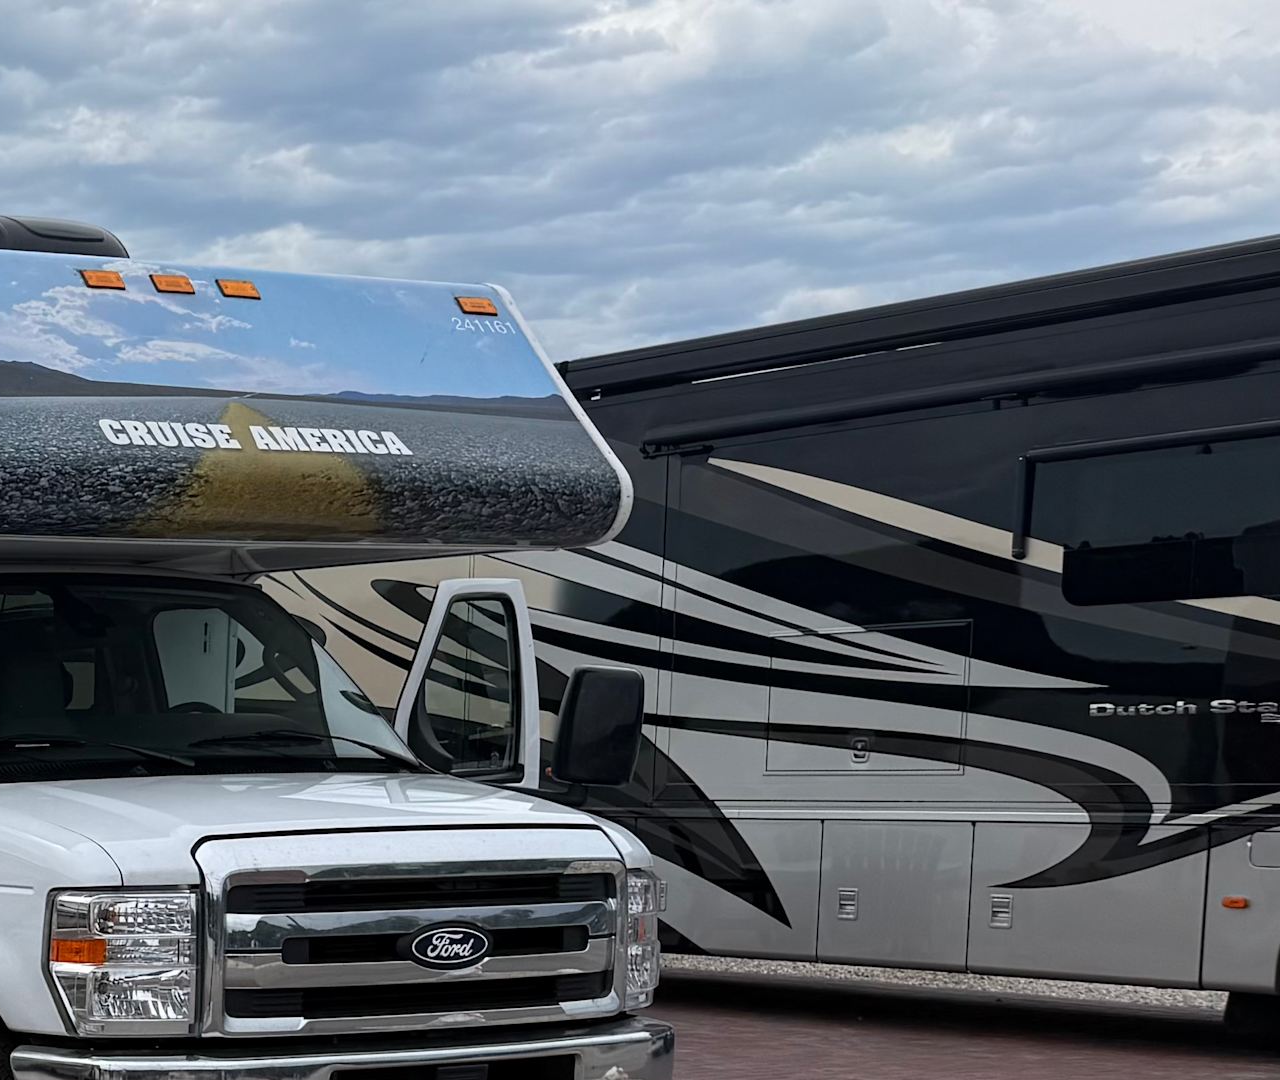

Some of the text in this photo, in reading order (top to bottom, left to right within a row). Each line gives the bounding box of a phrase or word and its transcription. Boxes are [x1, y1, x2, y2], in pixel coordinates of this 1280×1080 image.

[451, 316, 516, 335] 241161
[98, 418, 414, 456] CRUISE AMERICA
[1089, 700, 1198, 717] Dutch
[426, 932, 475, 958] Ford
